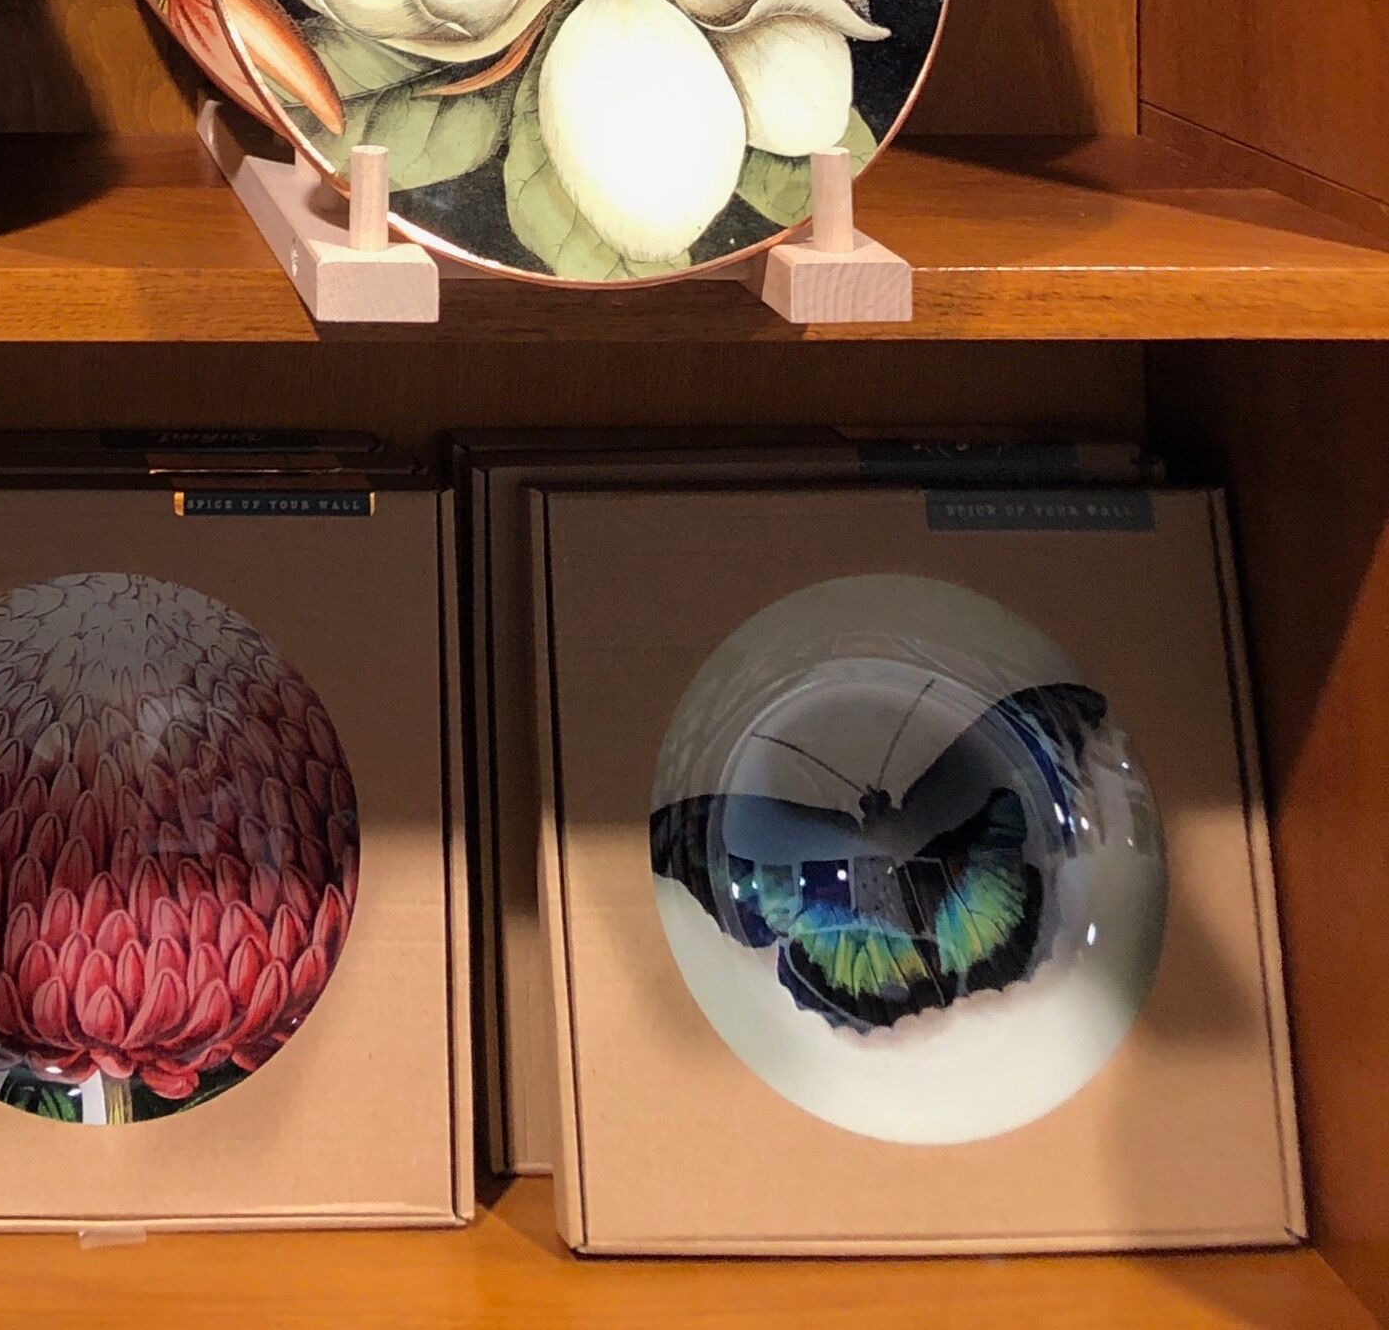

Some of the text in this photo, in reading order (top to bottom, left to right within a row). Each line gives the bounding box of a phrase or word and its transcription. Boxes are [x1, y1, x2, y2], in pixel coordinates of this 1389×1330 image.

[186, 498, 361, 511] SPICE UP YOUR WALL
